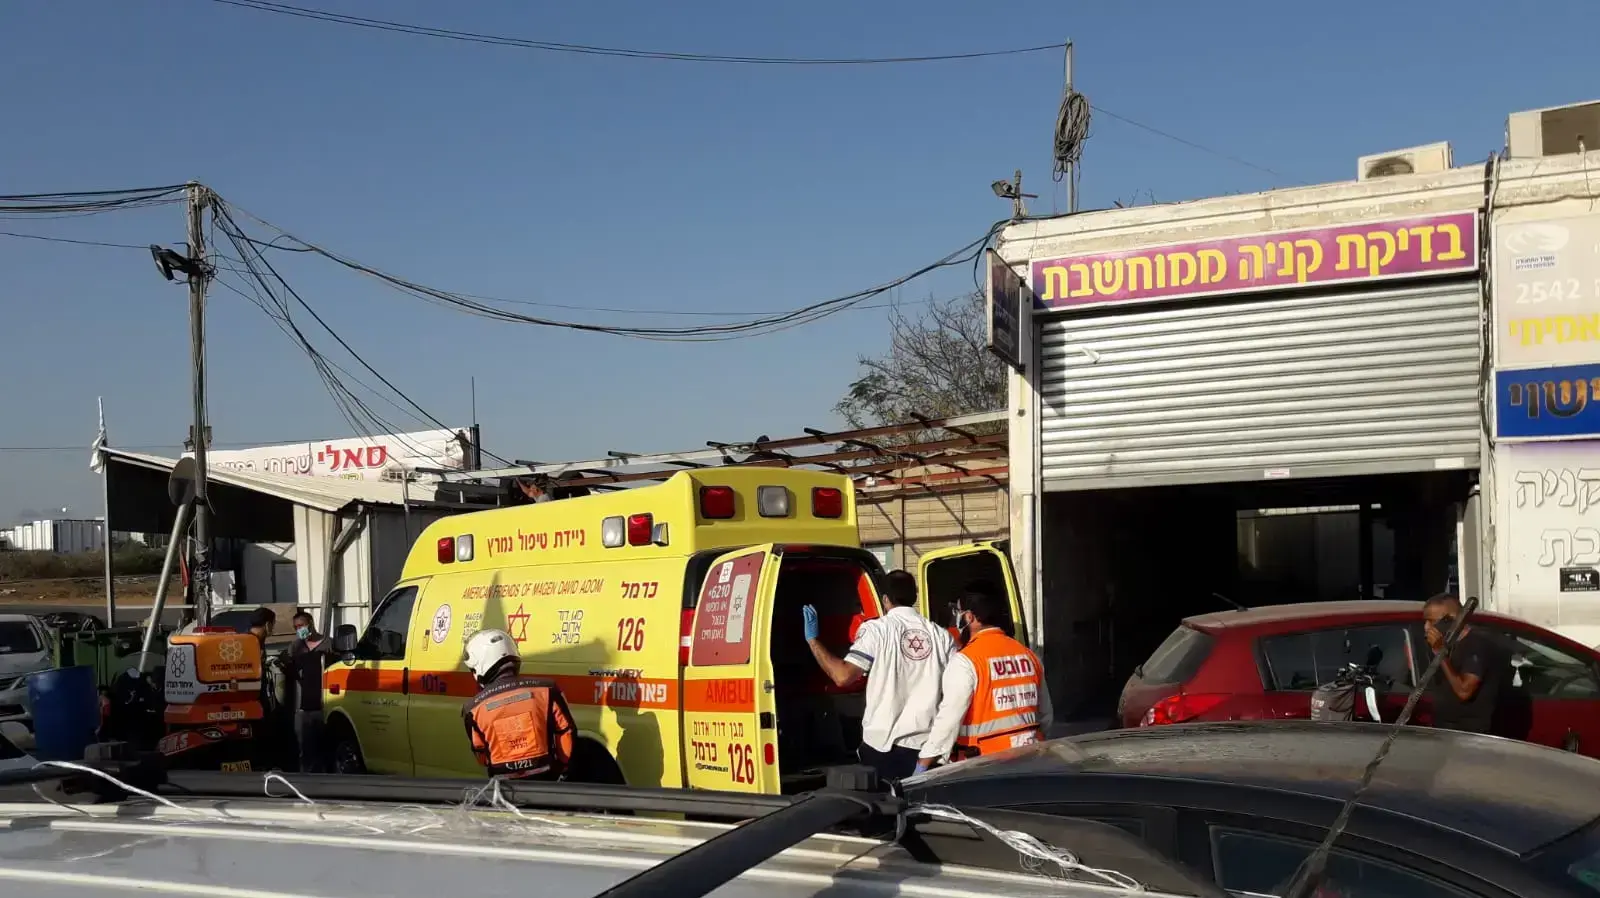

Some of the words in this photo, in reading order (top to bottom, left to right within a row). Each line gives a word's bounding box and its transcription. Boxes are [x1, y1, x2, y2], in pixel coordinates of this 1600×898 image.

[1238, 239, 1323, 284] קניה
[1335, 223, 1466, 277] בדיקת
[1041, 248, 1228, 301] ממוחשבת
[1516, 277, 1581, 305] 2542
[317, 444, 386, 471] סאלי
[487, 536, 513, 558] נמרץ
[518, 528, 548, 551] טיפול
[553, 529, 585, 549] ניידת
[521, 582, 532, 597] OF
[532, 580, 556, 597] MAGEN
[557, 579, 579, 595] DAVID
[579, 578, 604, 594] ADOM
[621, 580, 658, 599] כרמל
[617, 617, 645, 651] 126
[993, 658, 1032, 676] חובש
[693, 719, 710, 737] אדום
[712, 721, 726, 737] דוד
[729, 721, 744, 740] מגן
[691, 738, 717, 762] כרמל
[727, 742, 755, 785] 126
